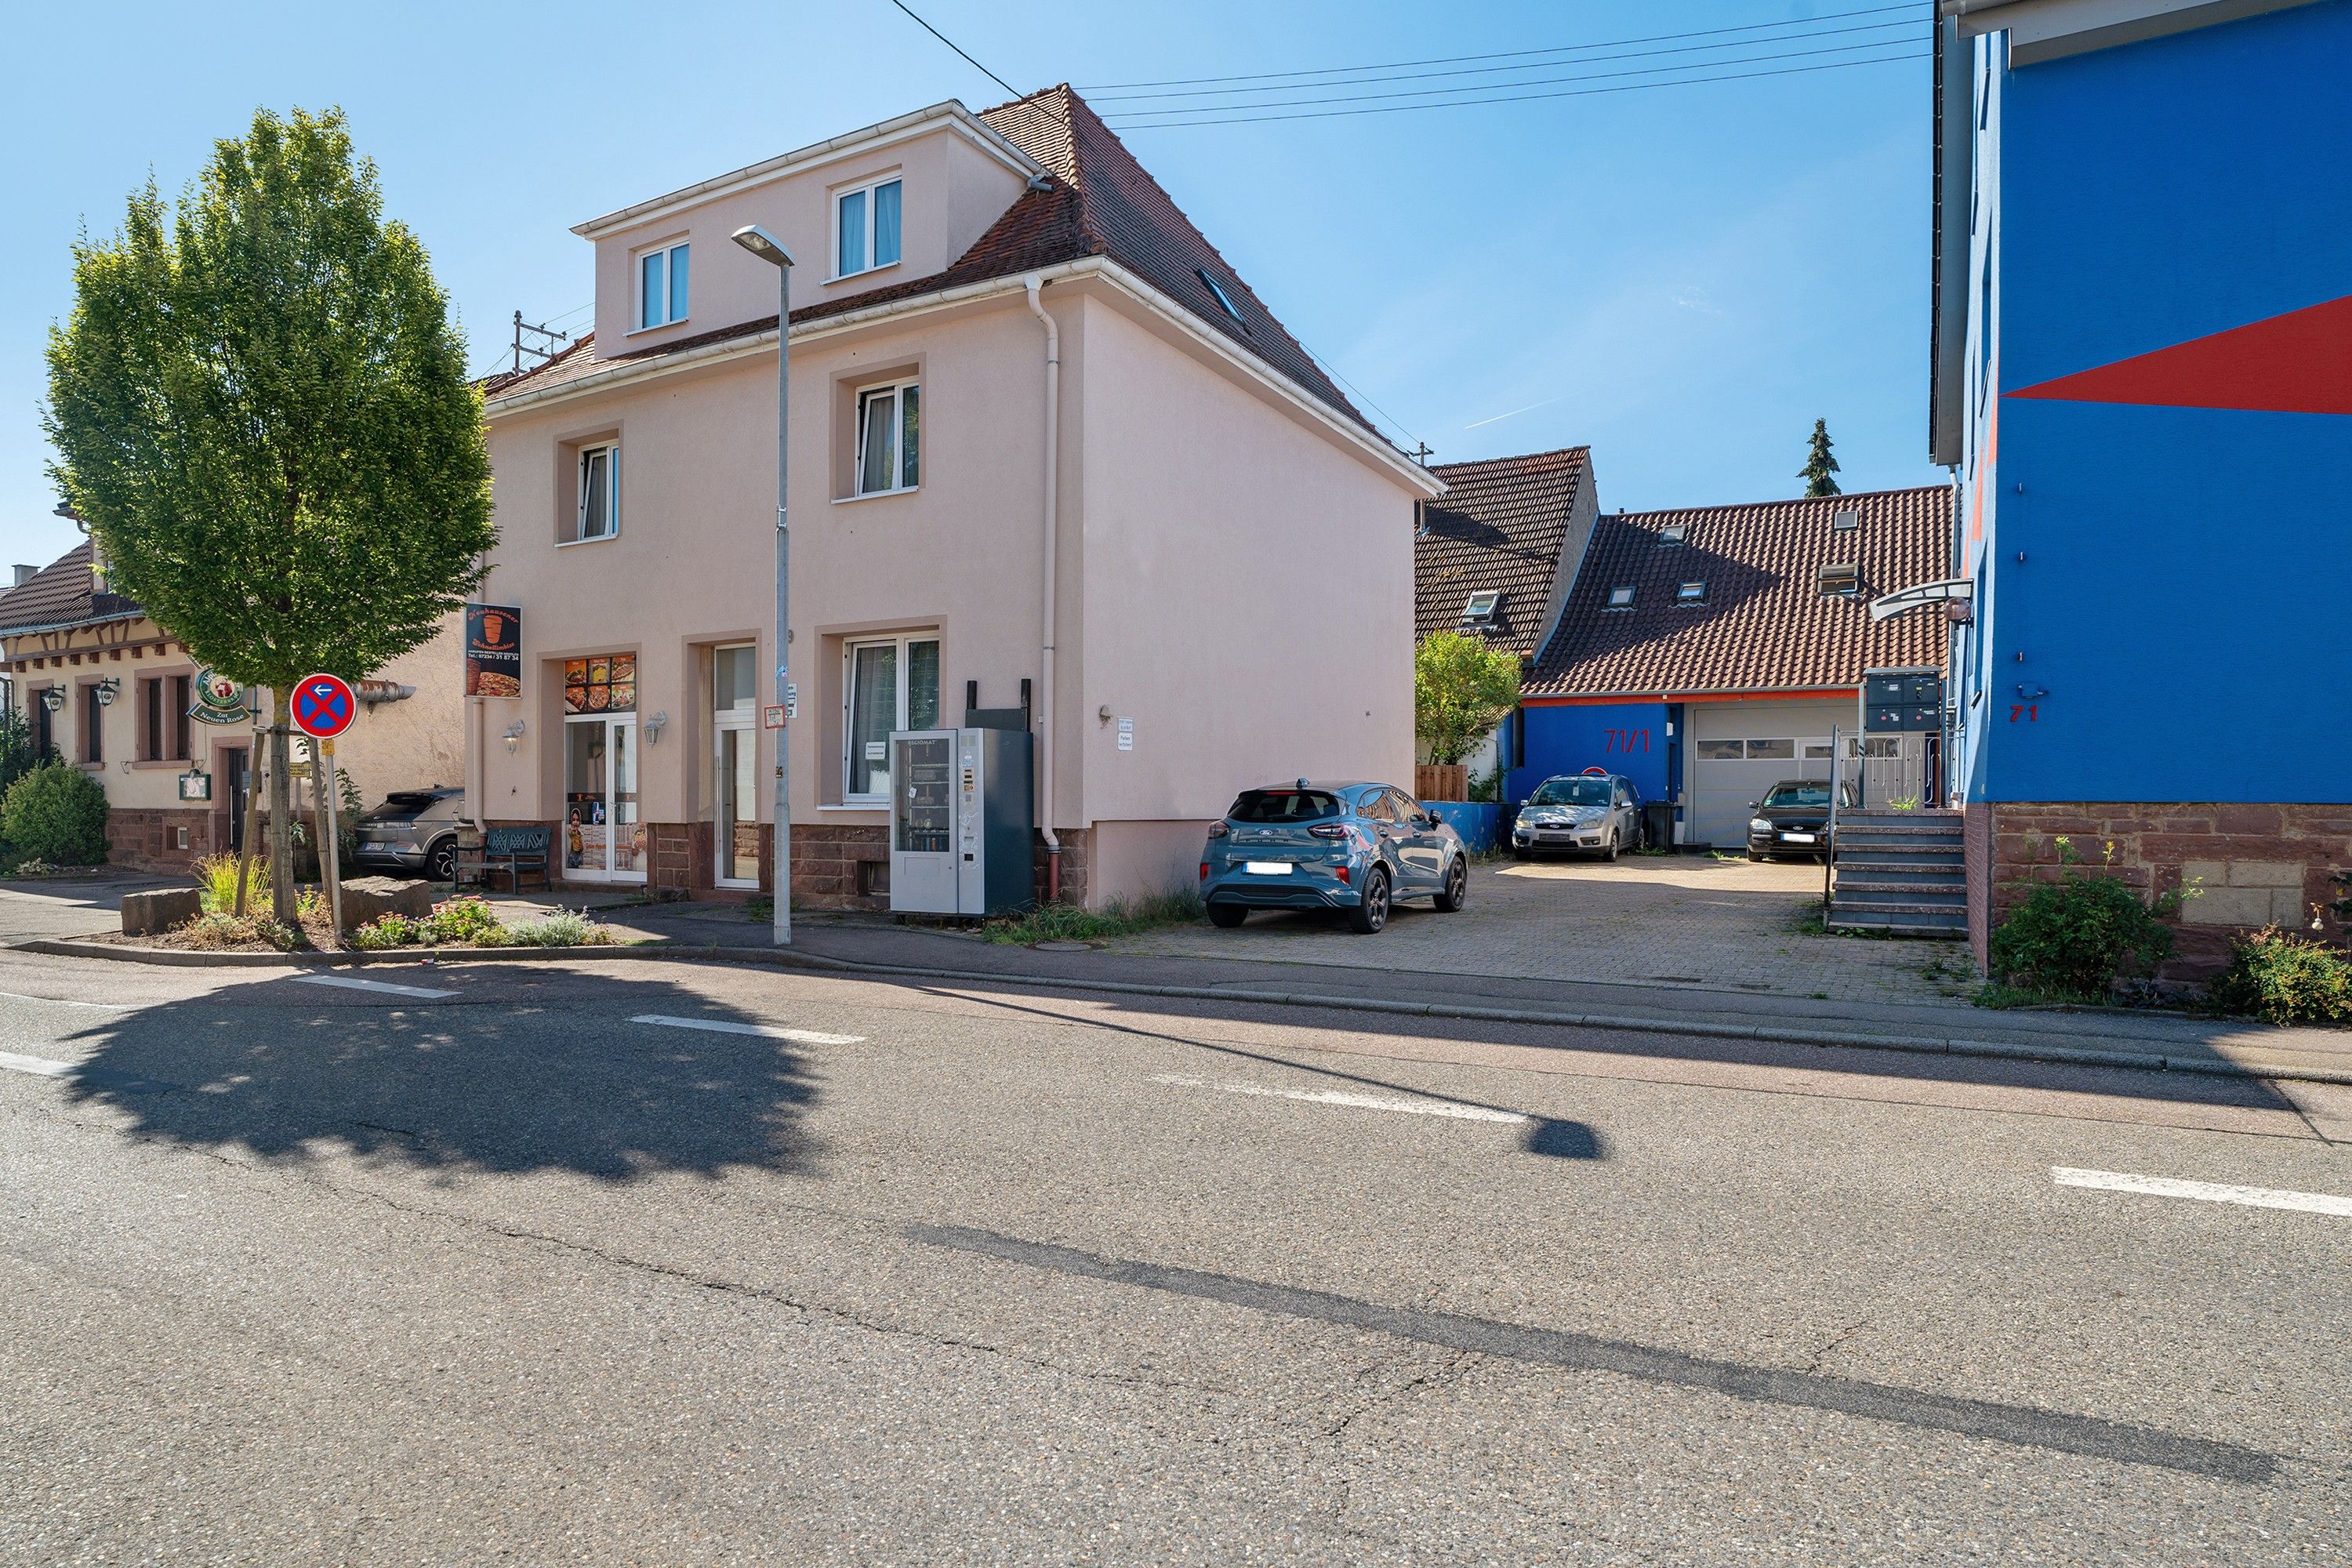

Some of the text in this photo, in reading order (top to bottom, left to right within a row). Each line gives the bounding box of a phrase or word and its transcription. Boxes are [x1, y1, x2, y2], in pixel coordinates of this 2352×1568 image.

[200, 712, 245, 724] Neuen Rose
[2010, 705, 2038, 723] 71
[1605, 729, 1649, 753] 71/1
